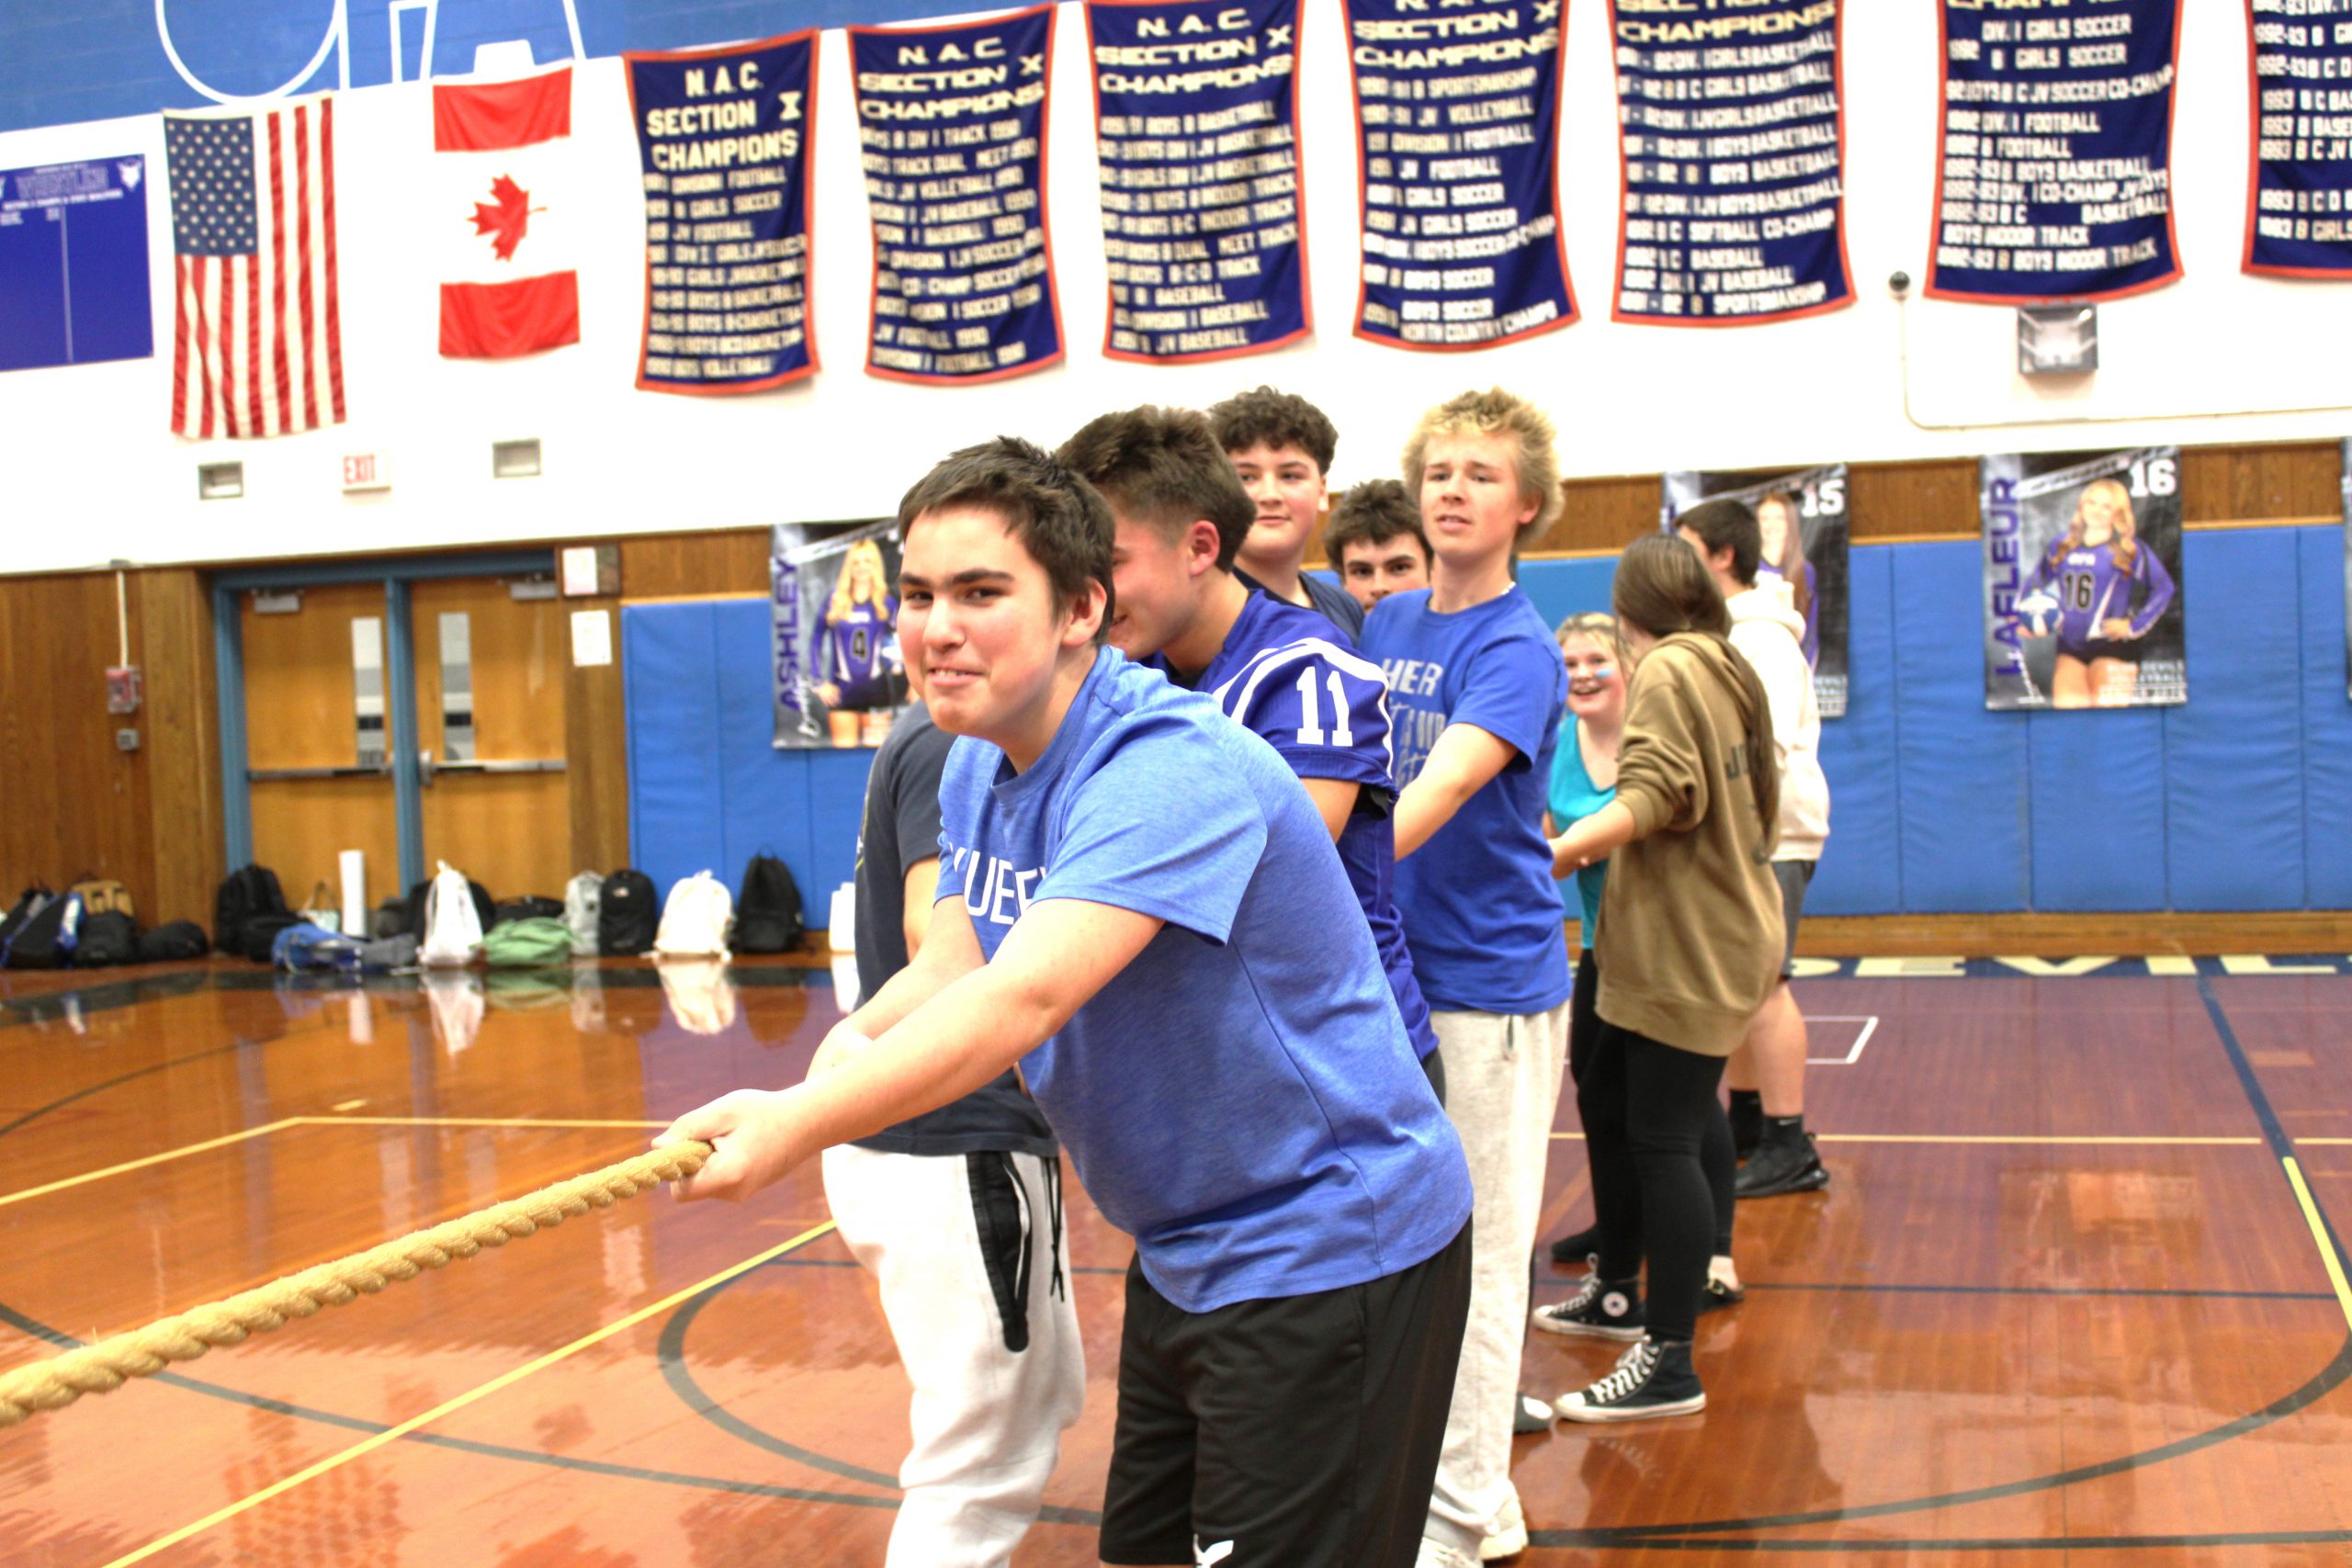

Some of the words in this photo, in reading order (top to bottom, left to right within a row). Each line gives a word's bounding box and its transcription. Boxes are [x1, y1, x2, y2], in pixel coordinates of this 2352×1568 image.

[1352, 9, 1519, 40] SECTION
[1532, 1, 1559, 23] X
[1617, 1, 1836, 43] CHAMPIONS
[2026, 17, 2071, 41] GIRLS
[2074, 13, 2132, 39] SOCCER
[1094, 36, 1257, 66] SECTION
[1266, 24, 1293, 49] X
[1354, 27, 1560, 70] CHAMPIONS
[2015, 47, 2061, 70] GIRLS
[2068, 42, 2127, 67] SOCCER
[858, 64, 1008, 92] SECTION
[1018, 53, 1044, 76] X
[1099, 53, 1295, 95] CHAMPIONS
[2323, 57, 2336, 78] C
[859, 81, 1046, 119] CHAMPIONS
[2030, 83, 2050, 104] JV
[2051, 80, 2108, 104] SOCCER
[2314, 89, 2327, 110] C
[647, 99, 757, 137] SECTION
[1448, 95, 1535, 125] VOLLEYBALL
[2024, 110, 2102, 133] FOOTBALL
[651, 128, 798, 171] CHAMPIONS
[1463, 122, 1535, 151] FOOTBALL
[1995, 136, 2073, 159] FOOTBALL
[2311, 138, 2325, 160] C
[2326, 138, 2347, 161] JV
[1429, 154, 1502, 181] FOOTBALL
[2016, 159, 2055, 182] BOYS
[2056, 153, 2149, 183] BASKETBALL
[1450, 183, 1506, 206] SOCCER
[2039, 181, 2118, 204] CO-CHAMP
[2311, 189, 2325, 212] C
[1464, 207, 1519, 233] SOCCER
[2014, 203, 2029, 224] C
[2081, 191, 2169, 225] BASKETBALL
[1689, 220, 1760, 242] SOFTBALL
[1943, 222, 1984, 245] BOYS
[2041, 224, 2091, 247] TRACK
[1690, 245, 1765, 270] BASEBALL
[2012, 248, 2054, 272] BOYS
[2111, 236, 2159, 268] TRACK
[1442, 265, 1496, 290] SOCCER
[1721, 265, 1794, 292] BASEBALL
[2129, 458, 2177, 498] 16
[1802, 479, 1844, 517] 15
[1989, 478, 2022, 676] LAFLEUR
[2064, 570, 2093, 614] 16
[776, 558, 801, 712] ASHLEY
[849, 626, 869, 663] 4
[1296, 665, 1353, 747] 11
